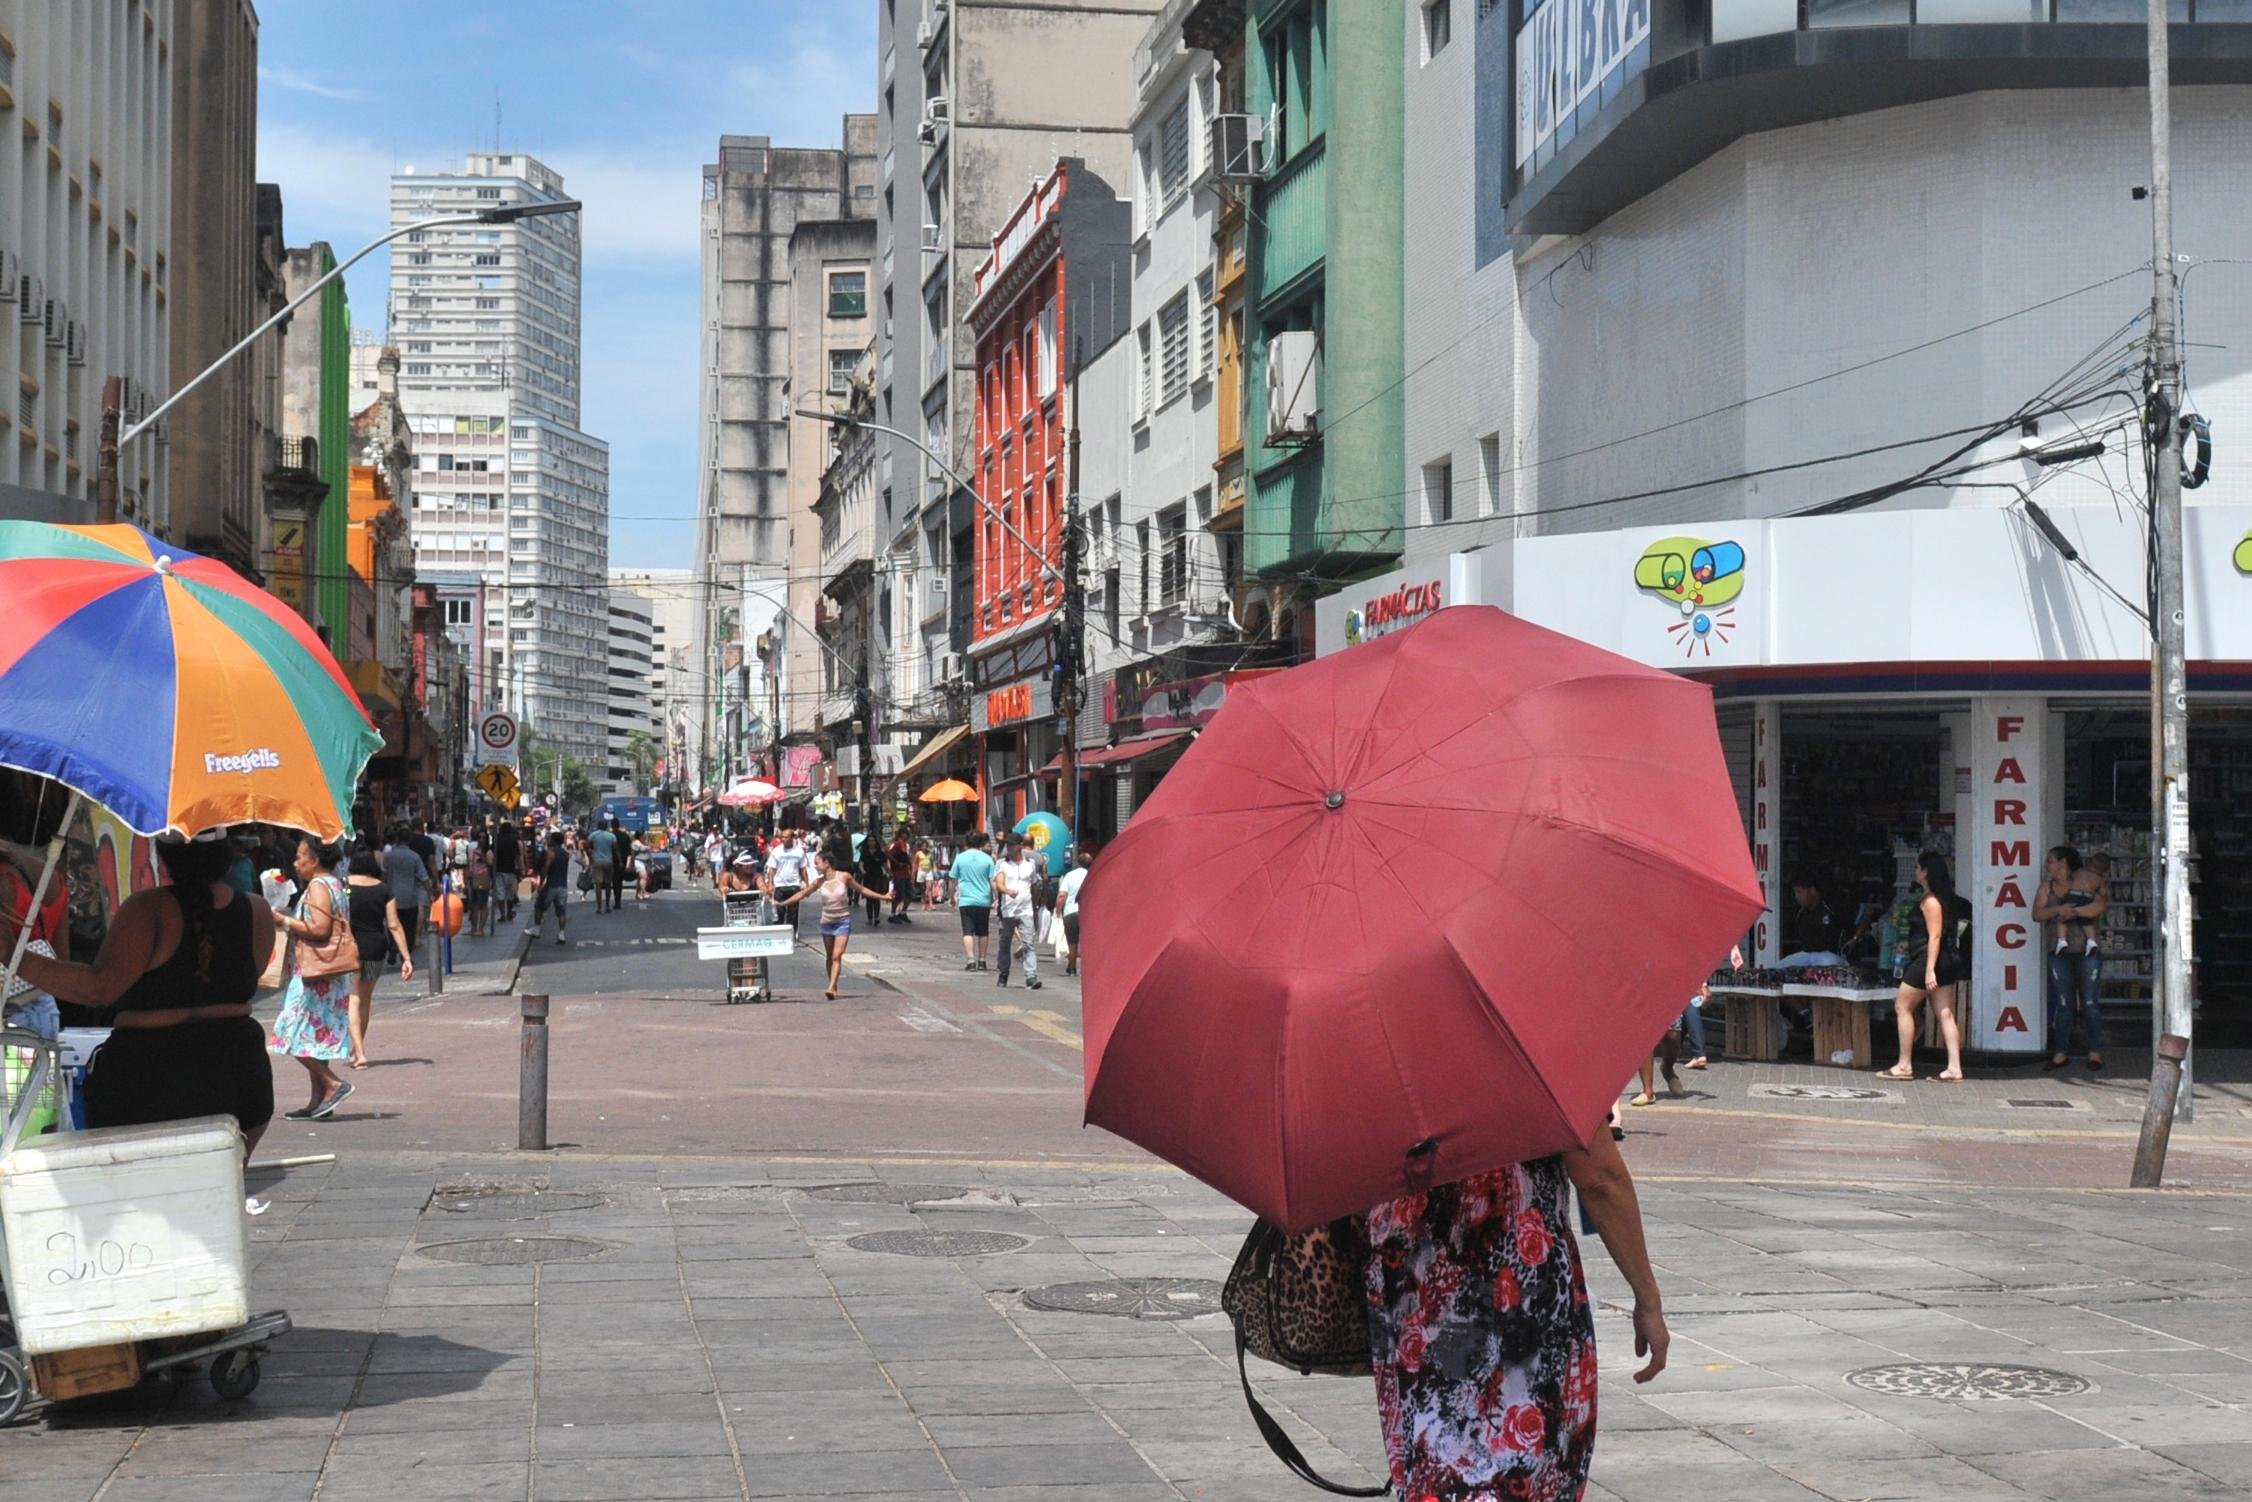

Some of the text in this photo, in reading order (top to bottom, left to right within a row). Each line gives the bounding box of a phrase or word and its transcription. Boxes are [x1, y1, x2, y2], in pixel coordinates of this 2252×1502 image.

[1537, 0, 1648, 133] ULBR
[488, 722, 509, 737] 20
[203, 748, 280, 774] Freegells
[1991, 716, 2031, 1032] FARMÁCIA
[46, 1231, 153, 1286] 2,00
